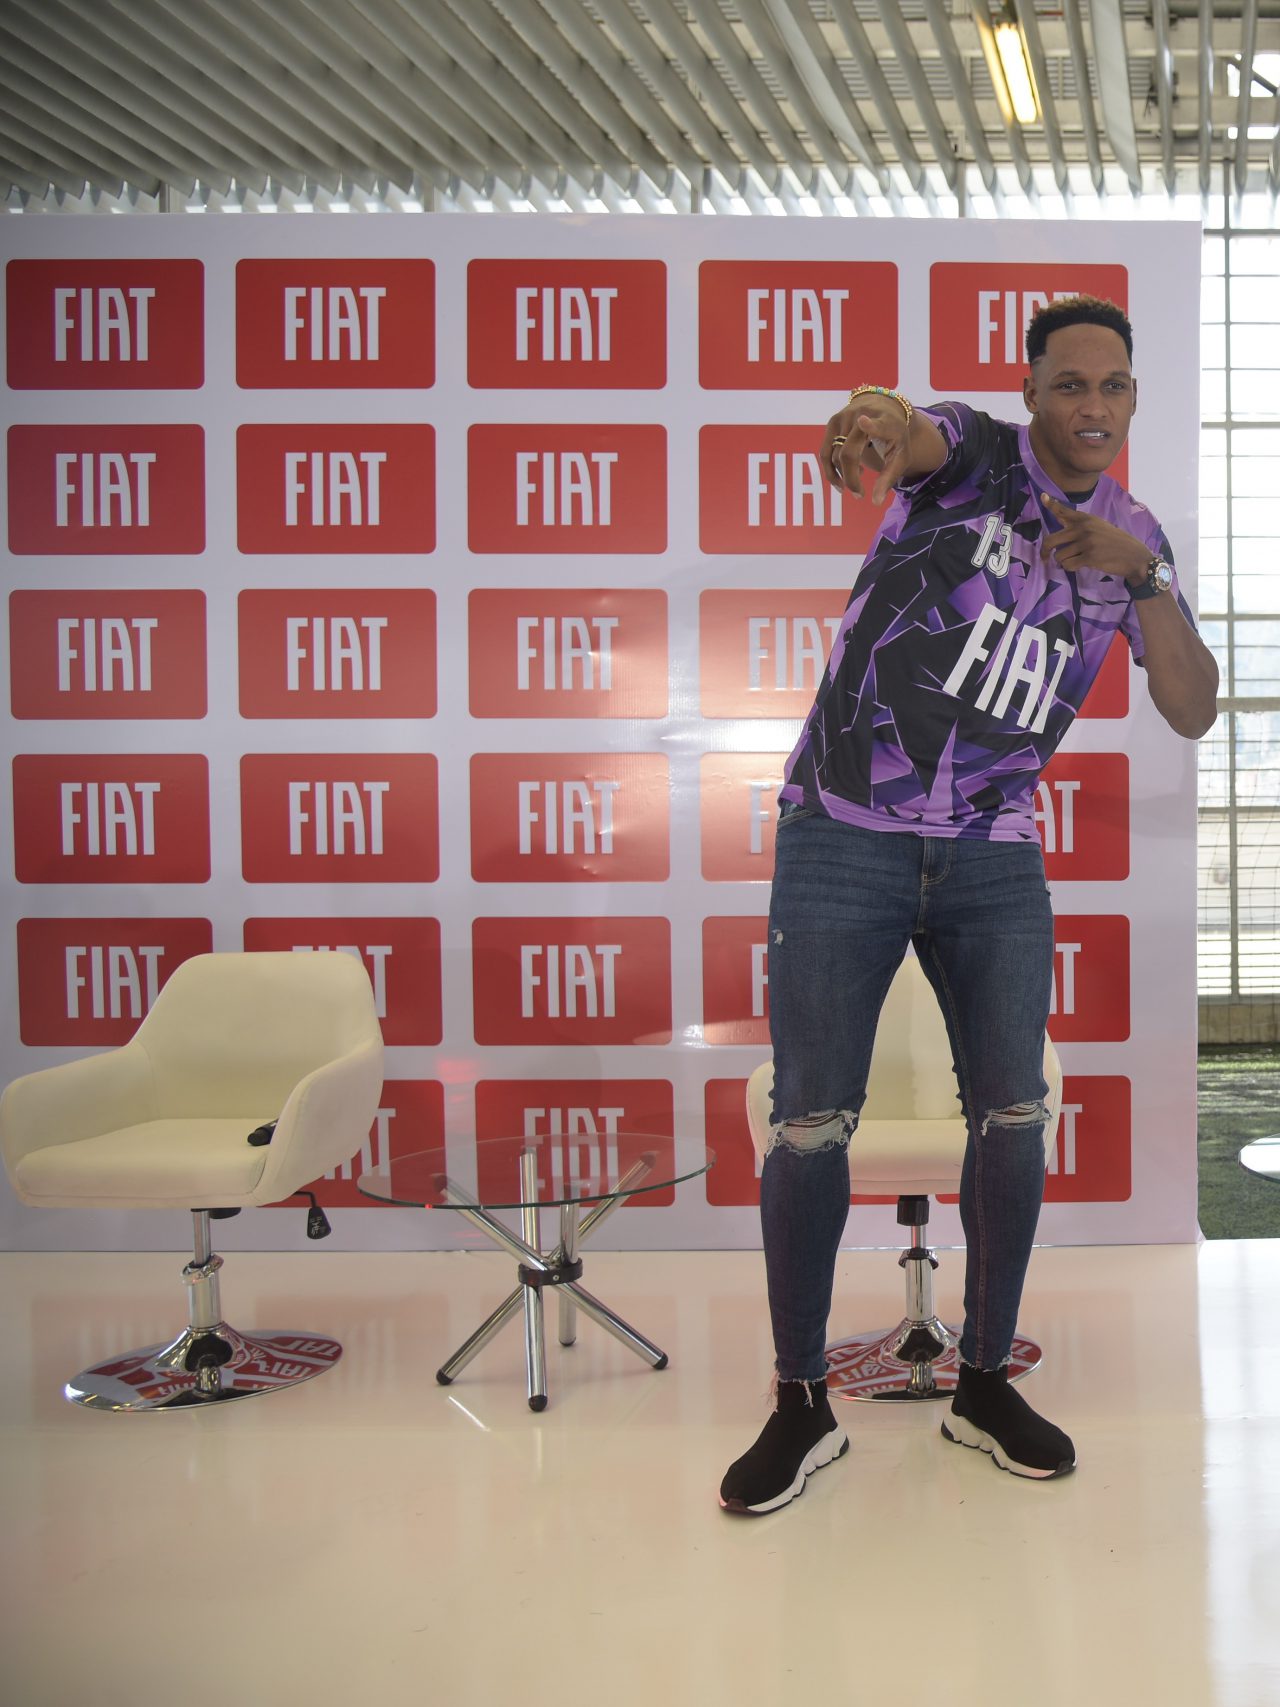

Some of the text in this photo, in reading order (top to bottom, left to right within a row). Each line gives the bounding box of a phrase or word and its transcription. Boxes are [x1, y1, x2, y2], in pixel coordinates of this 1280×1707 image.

[55, 288, 156, 361] FIAT
[284, 287, 386, 361] FIAT
[516, 287, 618, 361] FIAT
[747, 289, 849, 362] FIAT
[56, 453, 156, 527] FIAT
[285, 452, 387, 526] FIAT
[516, 452, 618, 526] FIAT
[971, 514, 1014, 579] 13
[58, 618, 158, 691] FIAT
[287, 617, 388, 691] FIAT
[517, 617, 619, 691] FIAT
[943, 602, 1076, 735] FIAT
[61, 782, 161, 856] FIAT
[288, 781, 390, 855] FIAT
[518, 781, 620, 855] FIAT
[66, 946, 165, 1018] FIAT
[520, 944, 622, 1018] FIAT
